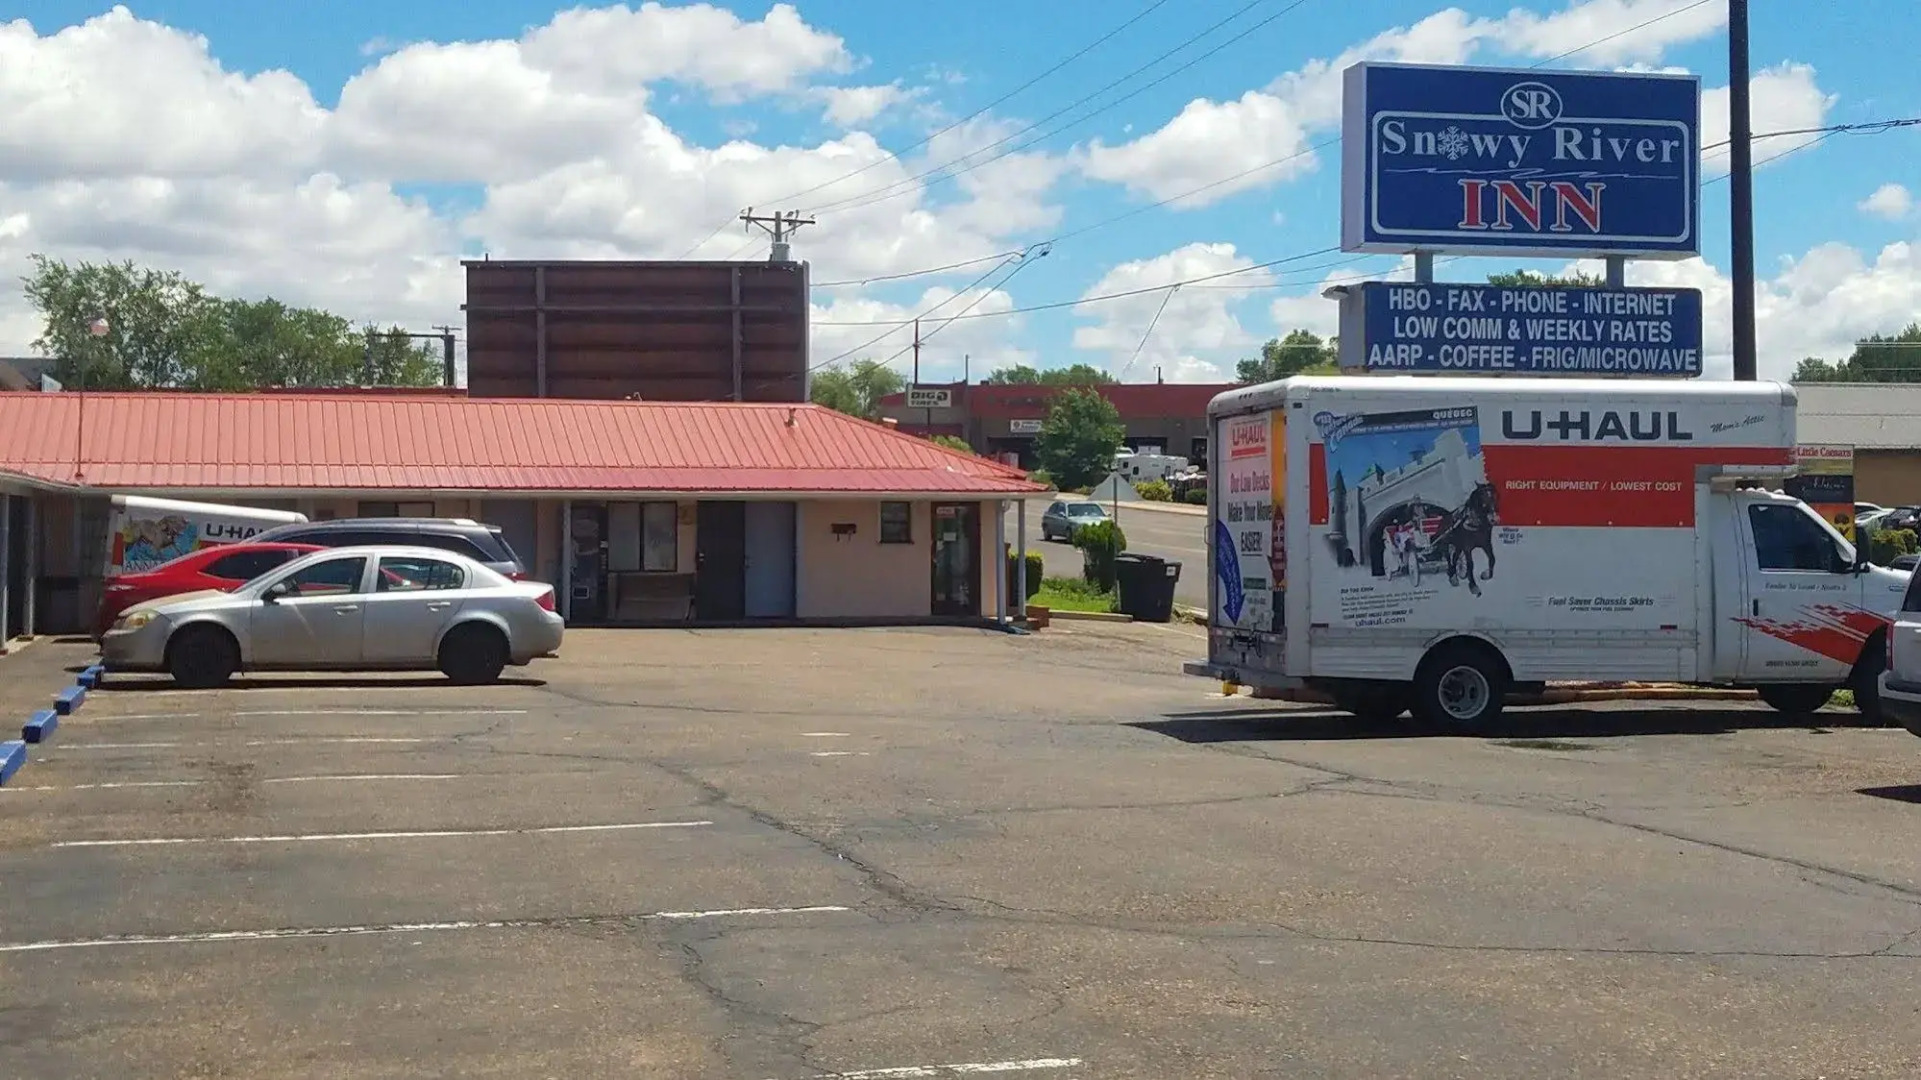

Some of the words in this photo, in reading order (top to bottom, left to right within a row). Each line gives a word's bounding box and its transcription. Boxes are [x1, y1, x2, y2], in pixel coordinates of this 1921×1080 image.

[1510, 90, 1554, 119] SR
[1553, 127, 1679, 163] River
[1458, 179, 1606, 233] INN
[1389, 288, 1431, 311] HBO
[1448, 289, 1485, 312] FAX
[1502, 290, 1567, 314] PHONE
[1584, 292, 1676, 315] INTERNET
[1394, 316, 1438, 338] LOW
[1443, 317, 1502, 340] COMM
[1507, 318, 1521, 341] &
[1525, 319, 1604, 341] WEEKLY
[1610, 321, 1672, 343] RATES
[1368, 344, 1423, 366] AARP
[1439, 344, 1515, 368] COFFEE
[1532, 346, 1697, 370] FRIG/MICROWAVE
[1232, 424, 1266, 447] U-HAUL
[1502, 410, 1693, 440] U-HAUL
[1252, 470, 1270, 492] Decks
[1505, 480, 1536, 490] RIGHT
[1539, 480, 1600, 491] EQUIPMENT
[1610, 481, 1652, 491] LOWEST
[1655, 482, 1682, 491] COST
[1228, 502, 1243, 522] Make
[1244, 501, 1256, 521] Your
[1256, 501, 1272, 521] Move
[206, 523, 264, 540] U-HA
[1548, 596, 1566, 606] Fuel
[1568, 596, 1591, 606] Saver
[1594, 596, 1627, 606] Chassis
[1629, 596, 1654, 606] Skirts
[1355, 617, 1406, 627] uhaul.com
